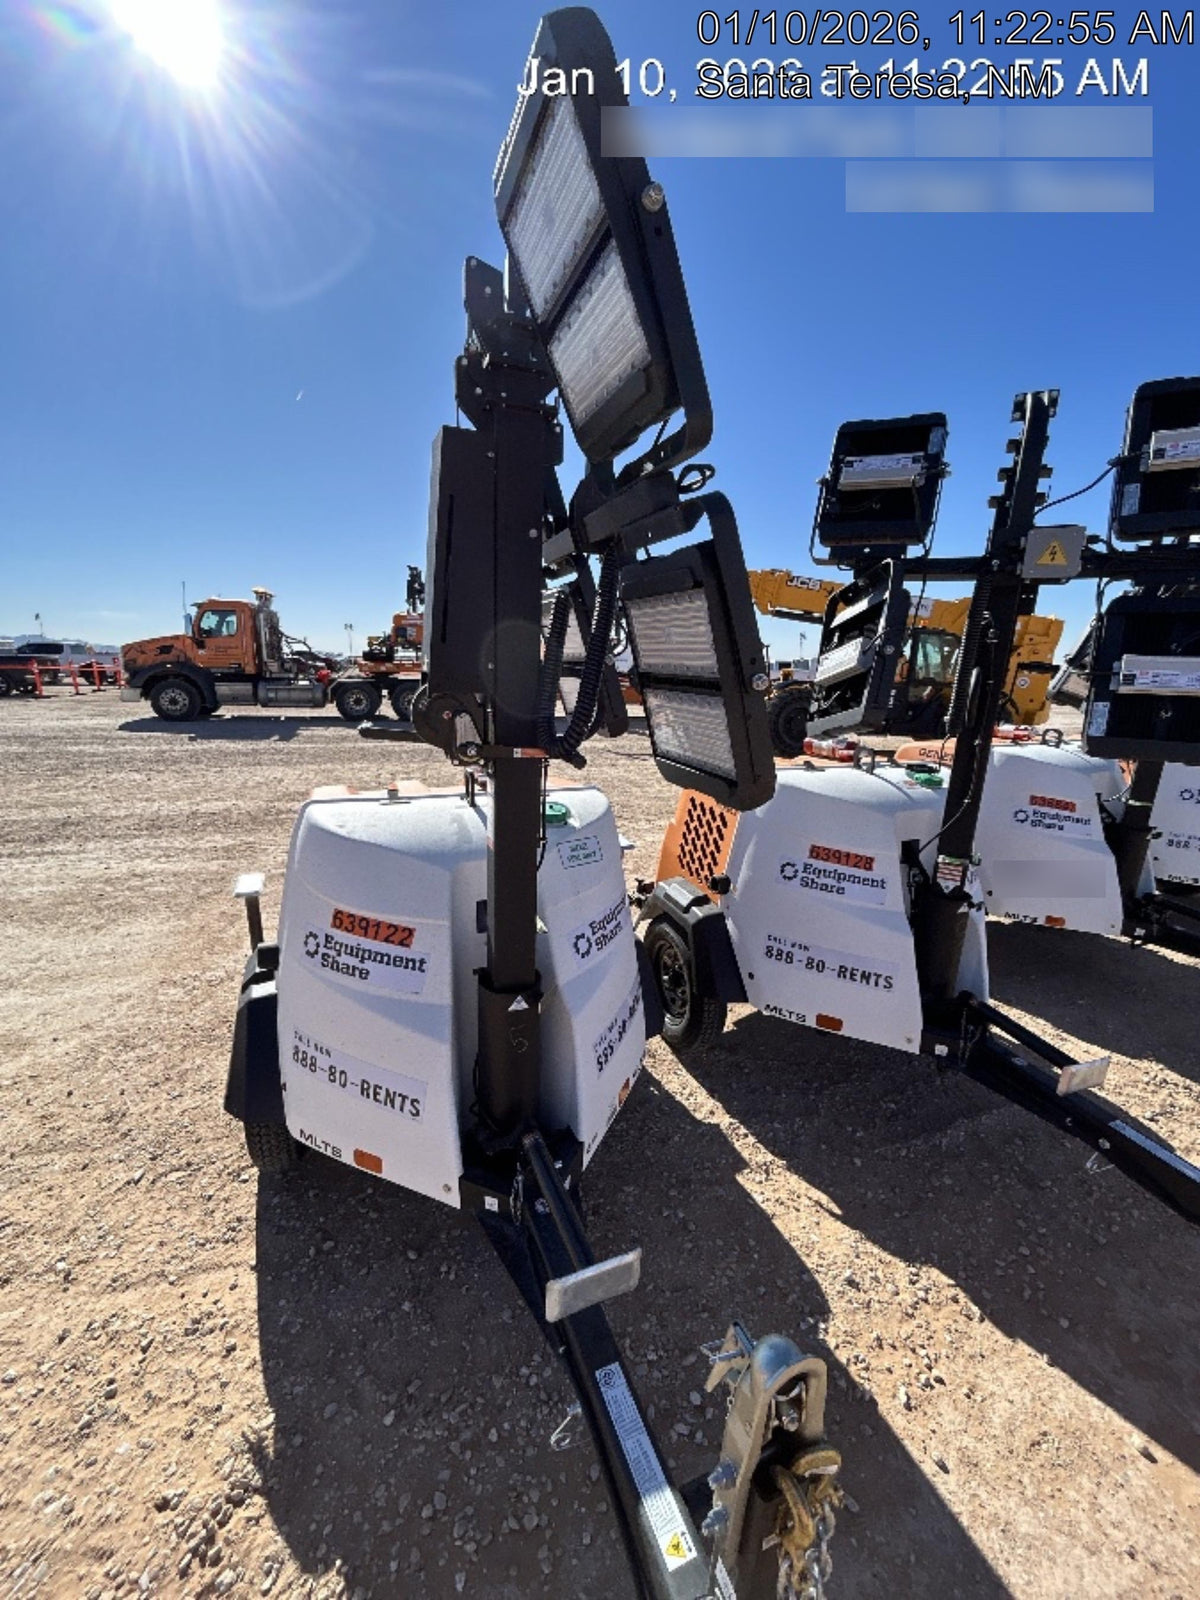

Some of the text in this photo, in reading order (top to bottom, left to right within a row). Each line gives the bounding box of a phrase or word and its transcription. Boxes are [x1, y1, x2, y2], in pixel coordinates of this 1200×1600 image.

[786, 576, 822, 590] JCB
[811, 845, 874, 871] 639128
[800, 876, 845, 895] Share
[801, 862, 887, 890] Equipment
[332, 910, 414, 947] 639122
[321, 952, 370, 981] Share
[322, 933, 427, 973] Equipment
[765, 945, 893, 989] 888-80-RENTS
[293, 1045, 420, 1117] 888-80-RENTS
[300, 1128, 342, 1158] MLTS
